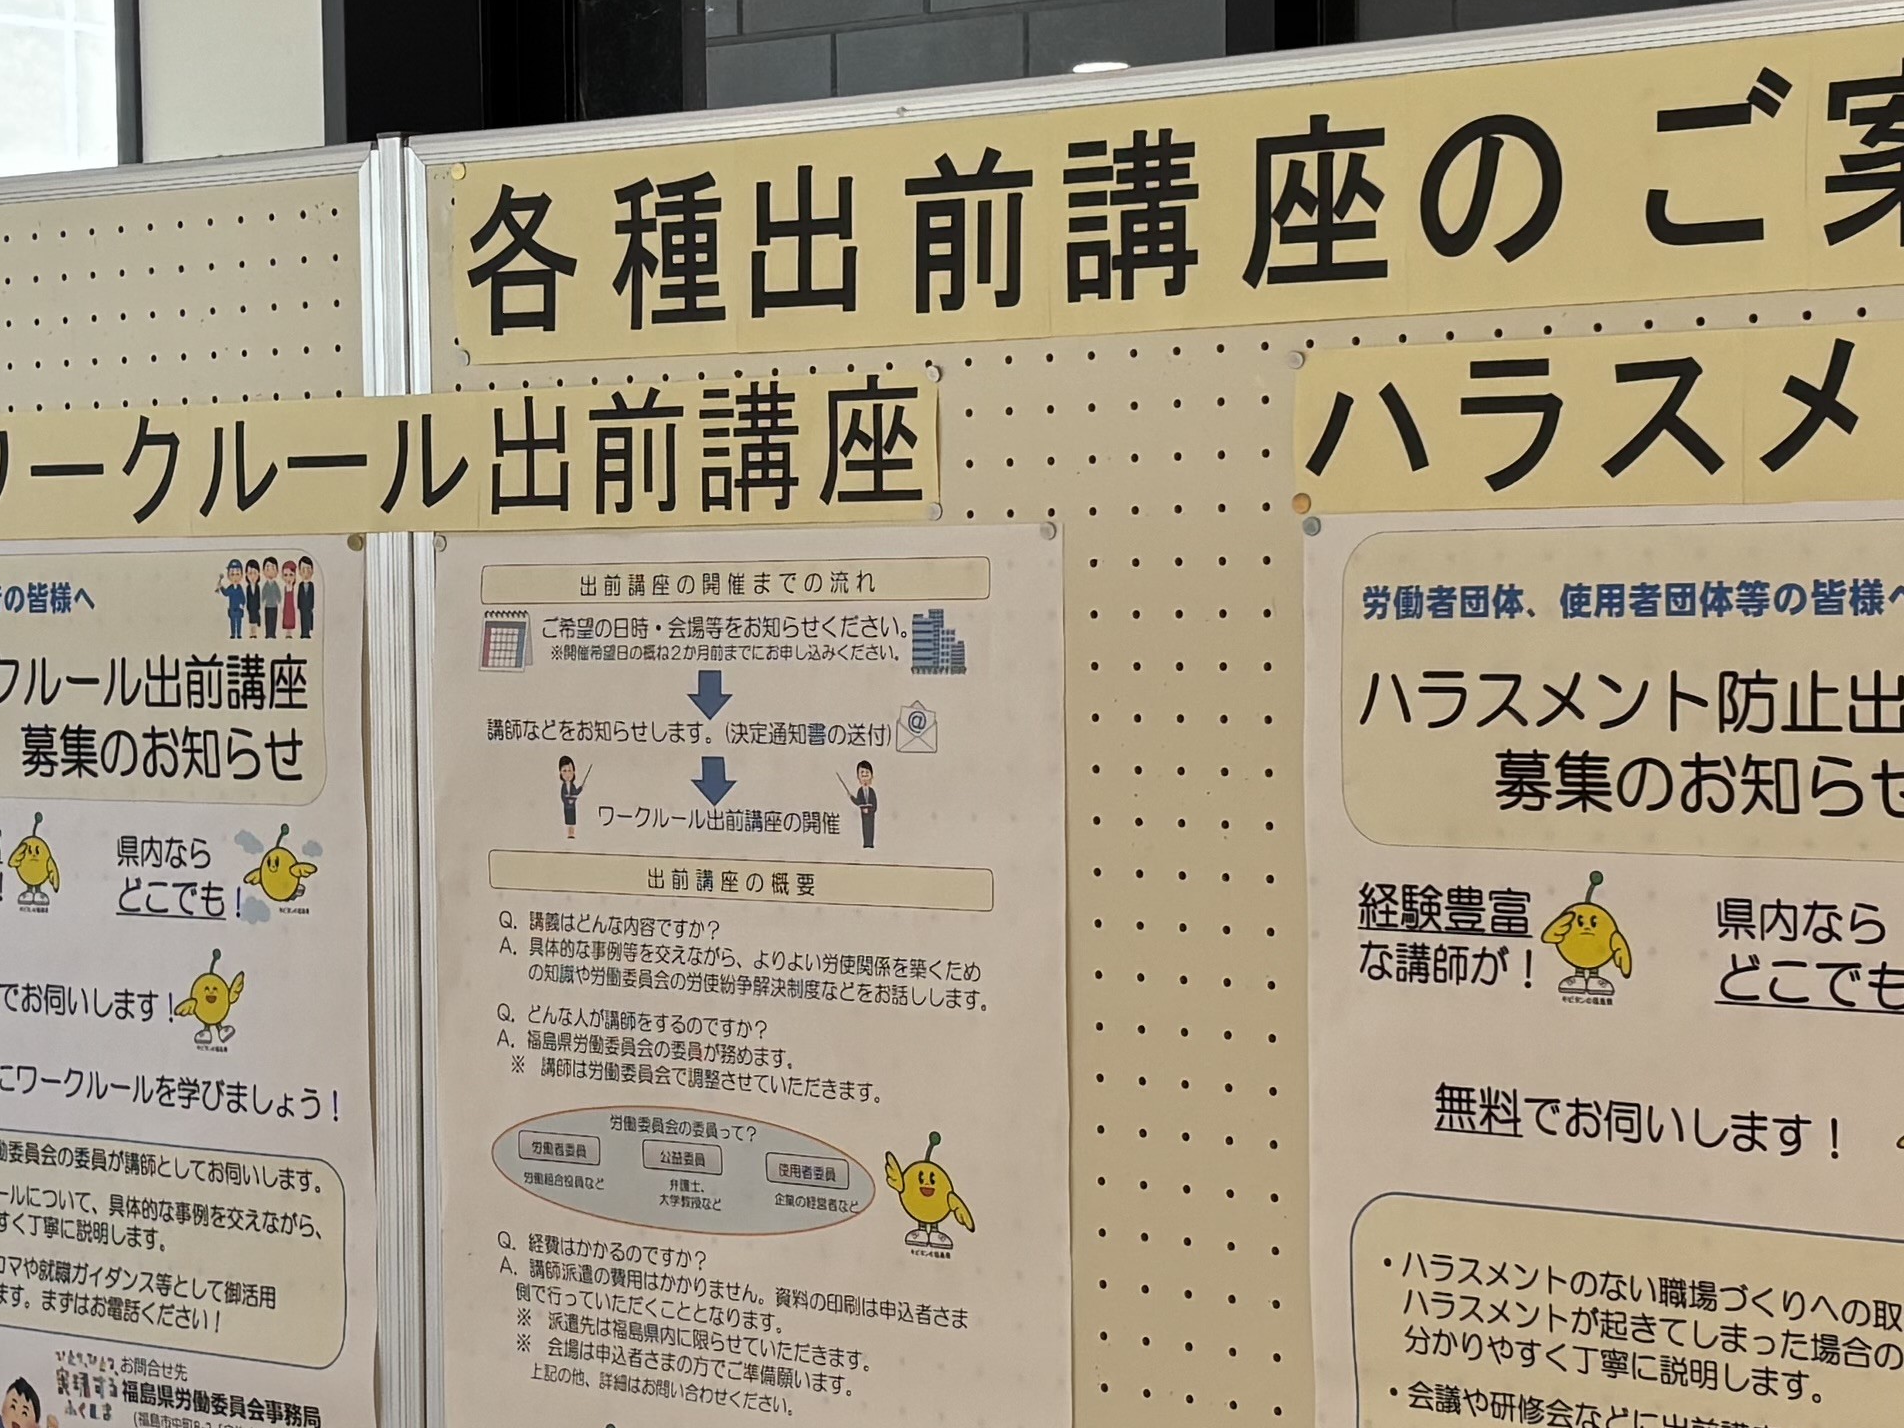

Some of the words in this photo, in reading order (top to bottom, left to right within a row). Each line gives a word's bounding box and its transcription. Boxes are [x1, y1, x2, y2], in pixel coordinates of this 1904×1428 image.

[580, 569, 877, 597] 出前講座の開催までの流れ
[541, 615, 908, 642] ご希望の日時・会場等をお知らせください。
[21, 724, 304, 781] 募集のお知らせ
[598, 805, 841, 836] ワークルール出前講座の開催
[117, 835, 211, 868] 県内なら
[116, 876, 242, 920] どこでも！
[647, 867, 817, 897] 出前講座の概要
[1358, 884, 1531, 933] 経験豊富
[1716, 898, 1886, 944] 県内なら
[1359, 940, 1533, 989] な講師が！
[528, 964, 987, 1013] の知識や労働委員会の労使紛争解決制度などをお話しします。
[541, 1057, 881, 1105] 講師は労働委員会で調整させていただきます。
[610, 1114, 758, 1143] 労働委員会の委員って？
[1434, 1083, 1839, 1159] 無料でお伺いします！
[531, 1140, 587, 1160] 労働者委員
[659, 1149, 706, 1169] 公益委員
[778, 1161, 837, 1183] 使用者委員
[515, 1283, 784, 1335] 側で行っていただくこととなります。
[548, 1311, 870, 1373] 派遣先は福島県内に限らせていただきます。
[1403, 1324, 1824, 1405] 分かりやすく丁寧に説明します。
[120, 1355, 188, 1382] お問合せ先
[530, 1363, 794, 1417] 上記の他、詳細はお問い合わせください。
[547, 1337, 853, 1397] 会場は申込者さまの方でご準備願います。
